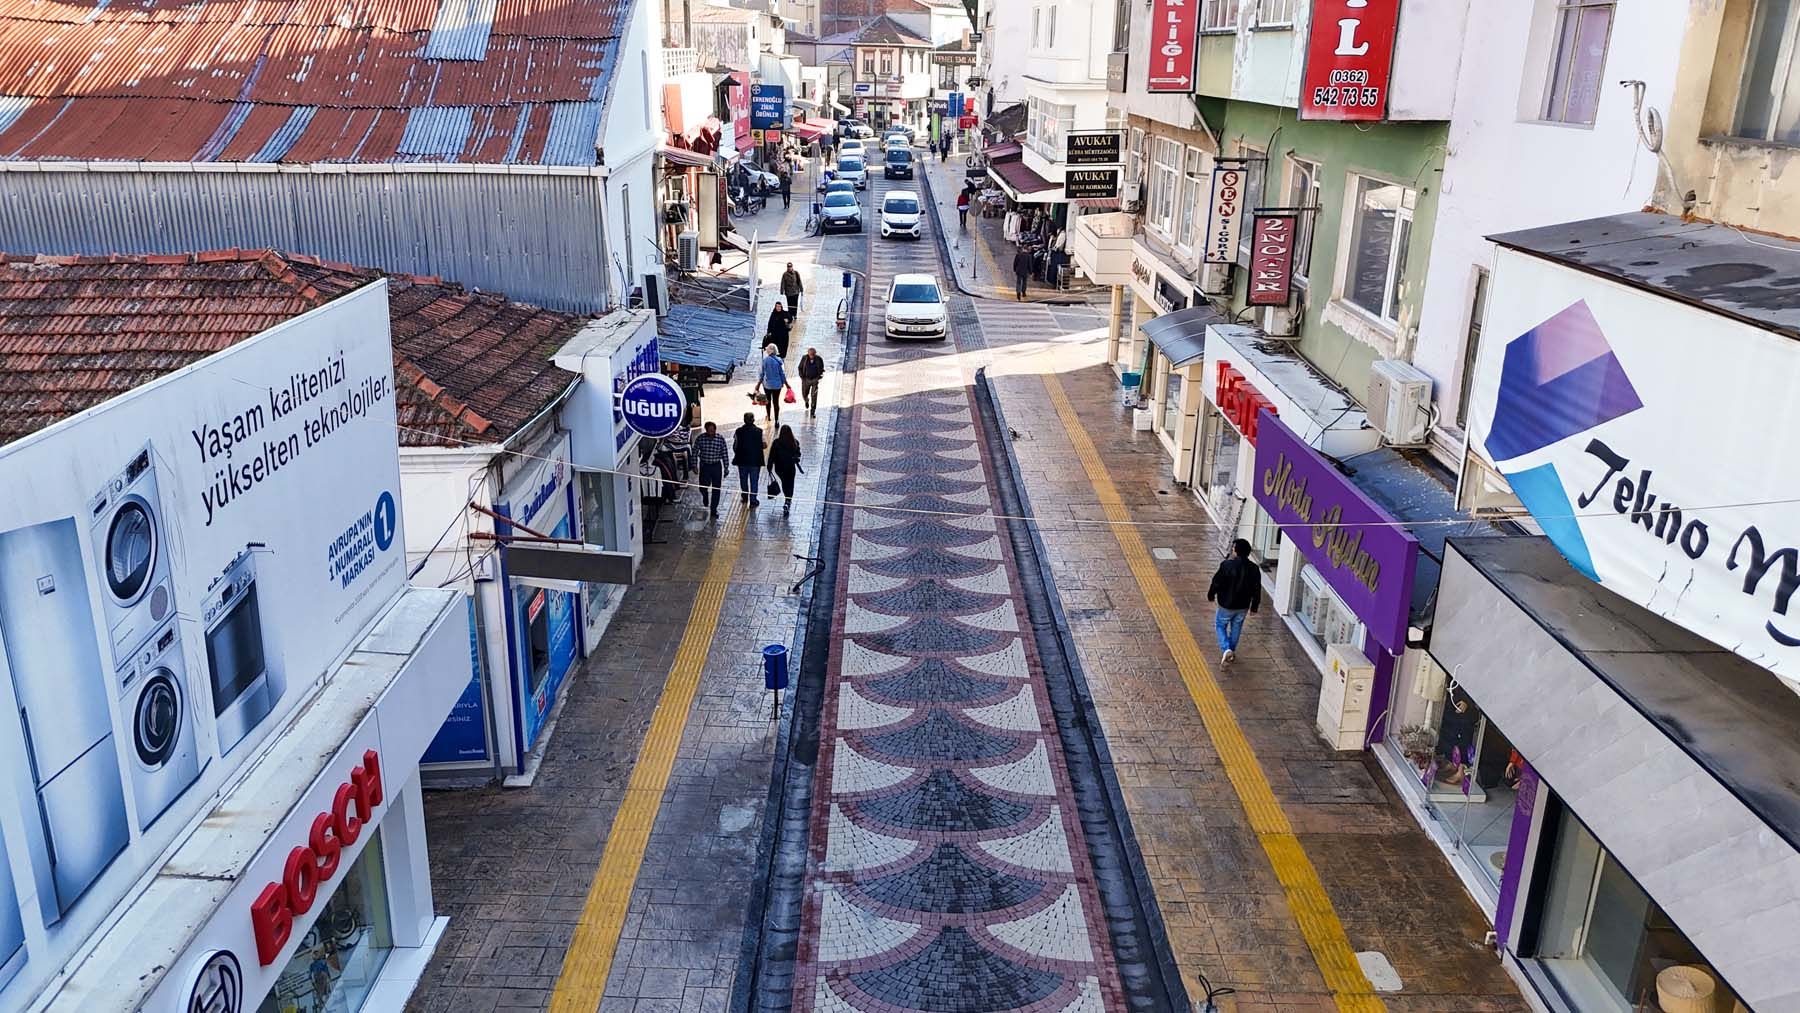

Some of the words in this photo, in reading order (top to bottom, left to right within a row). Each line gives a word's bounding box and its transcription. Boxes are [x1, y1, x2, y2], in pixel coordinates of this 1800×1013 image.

[1333, 0, 1369, 56] L
[1314, 87, 1339, 106] 542
[1341, 87, 1358, 106] 73
[1360, 87, 1378, 106] 55
[1330, 69, 1368, 86] (0362)
[1074, 136, 1113, 146] AVUKAT
[1073, 171, 1112, 181] AVUKAT
[192, 404, 265, 464] Yaşam
[269, 350, 346, 421] kalitenizi
[625, 398, 678, 418] UĞUR
[201, 433, 300, 526] yükselten
[304, 375, 390, 448] teknolojiler.
[1263, 451, 1314, 523] Moda
[1311, 503, 1380, 593] Aydan
[1577, 437, 1709, 561] Tekno
[328, 509, 373, 562] AVRUPA'NIN
[329, 566, 335, 582] 1
[335, 527, 374, 576] NUMARALI
[341, 545, 376, 591] MARKASI
[250, 748, 383, 967] BOSCH
